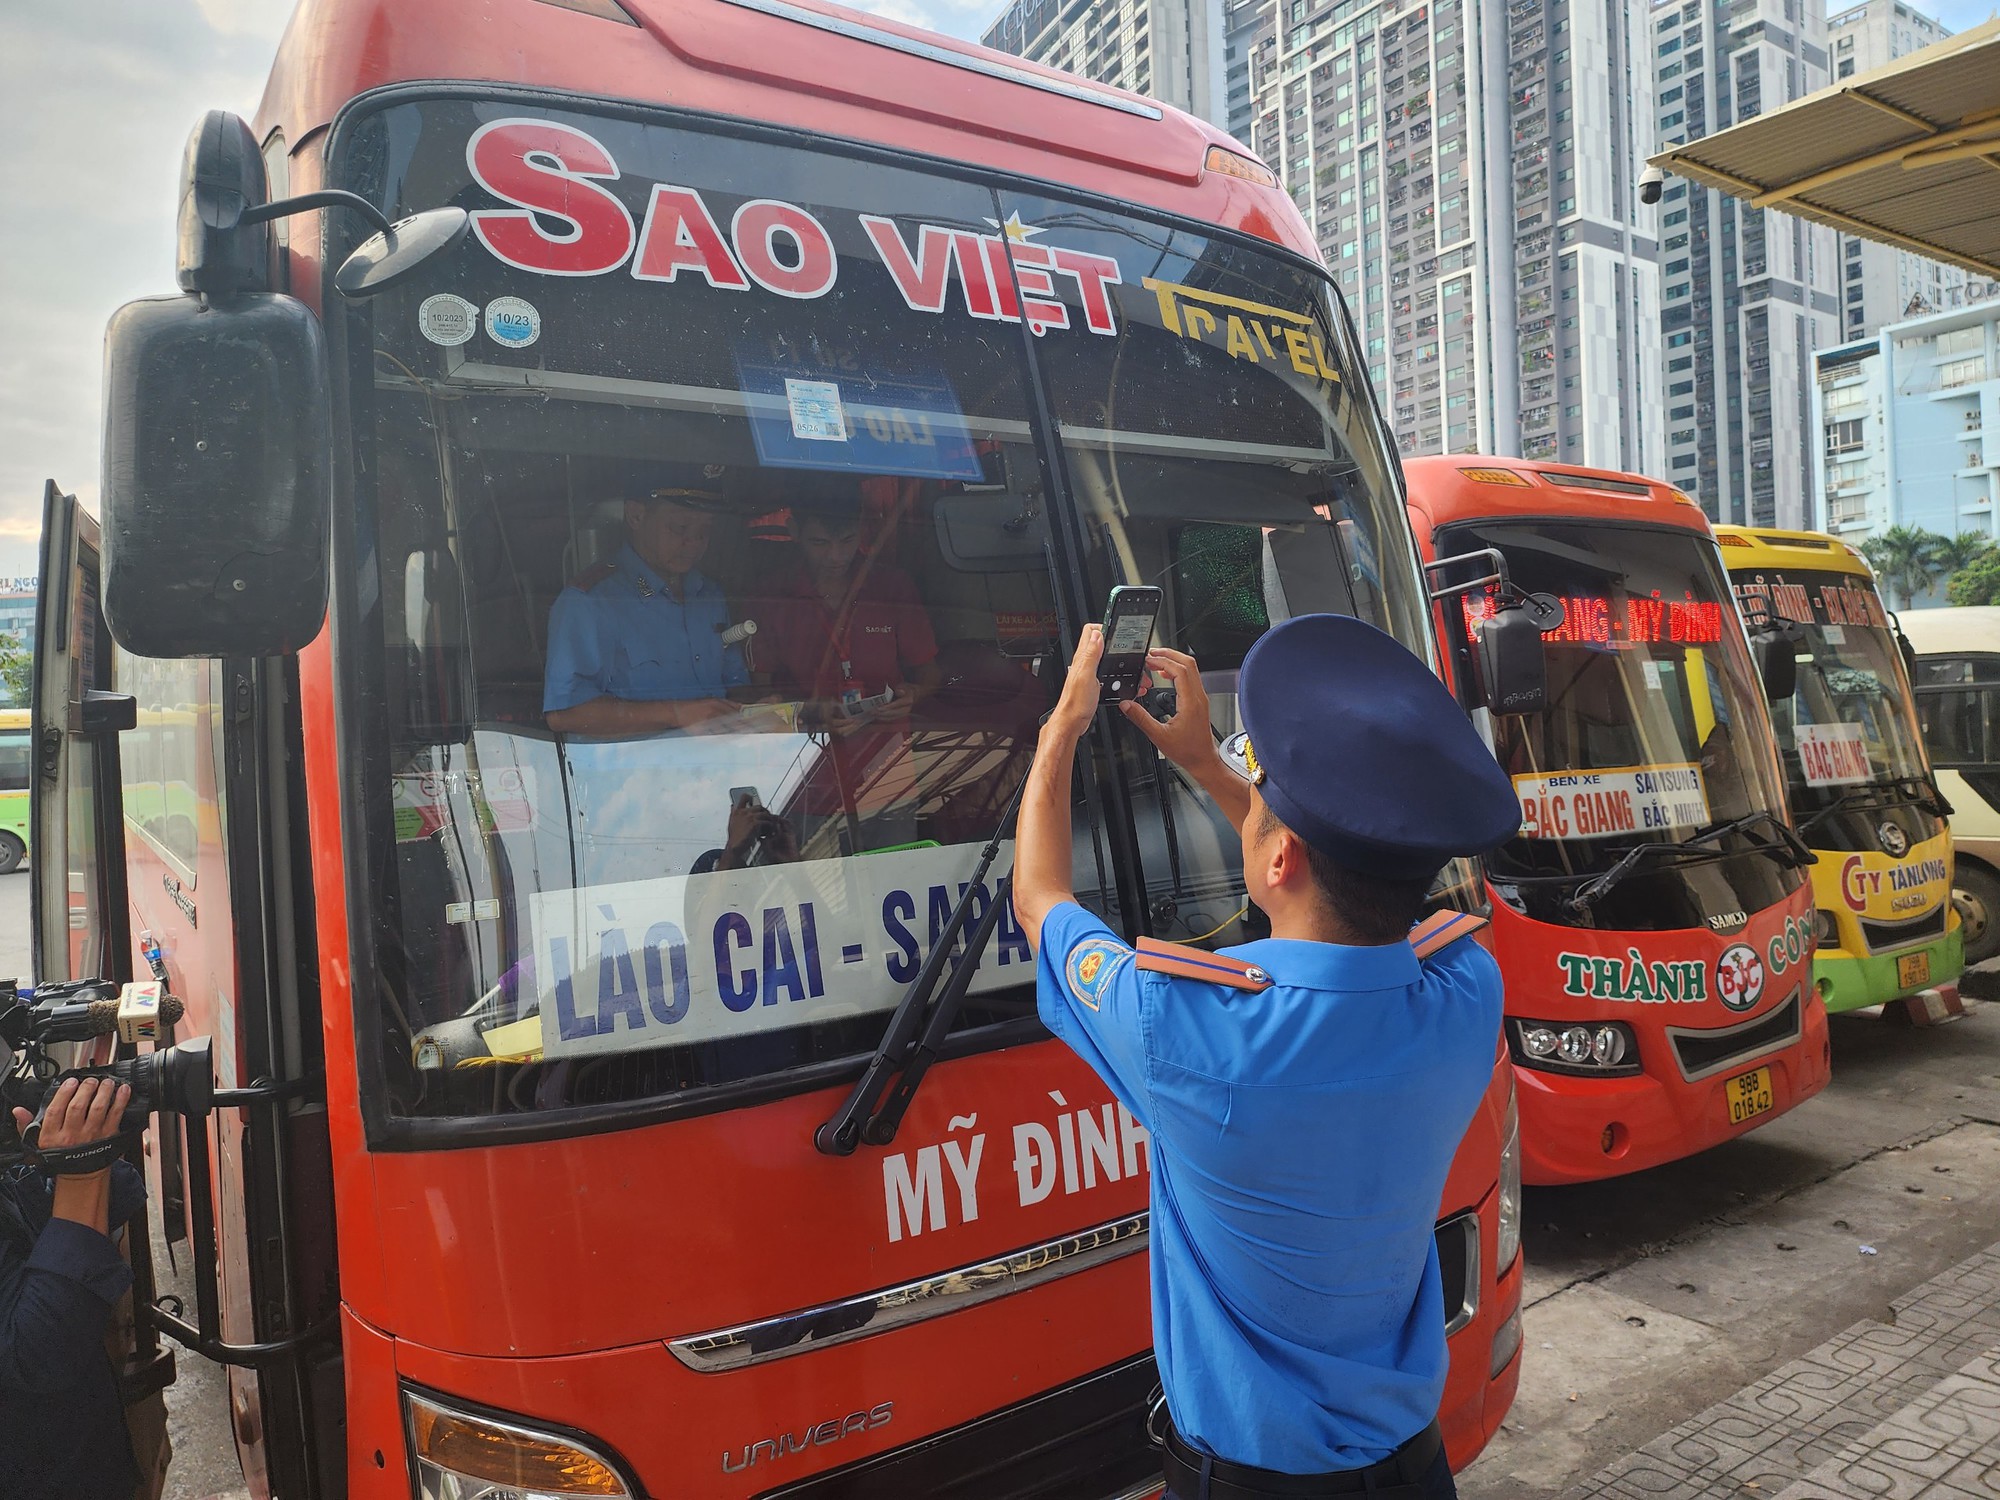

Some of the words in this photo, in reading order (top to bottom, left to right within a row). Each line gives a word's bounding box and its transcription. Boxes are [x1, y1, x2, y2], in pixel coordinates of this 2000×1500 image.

[466, 118, 838, 299] SAO
[432, 314, 464, 323] 10/2023
[496, 312, 530, 327] 10/23
[1141, 276, 1341, 383] TRAVEL
[797, 422, 819, 433] 05/26
[1627, 589, 1664, 642] MỸ
[1803, 727, 1832, 780] BẮC
[1830, 740, 1869, 778] GIANG
[1583, 774, 1601, 785] XE
[1635, 769, 1699, 795] SAMSUNG
[1522, 784, 1568, 839] BẮC
[1573, 790, 1635, 836] GIANG
[1643, 799, 1671, 828] BẮC
[1708, 911, 1748, 930] SAMCO
[549, 903, 691, 1042] LÀO
[712, 902, 825, 1013] CAI
[842, 943, 864, 964] -
[1557, 946, 1708, 1004] THÀNH
[1739, 1072, 1759, 1096] 98B
[1734, 1090, 1769, 1120] 018.42
[65, 1144, 112, 1160] FUJINON
[883, 1112, 986, 1243] MỸ
[1012, 1089, 1150, 1207] ĐÌNH
[721, 1401, 894, 1474] UNIVERS
